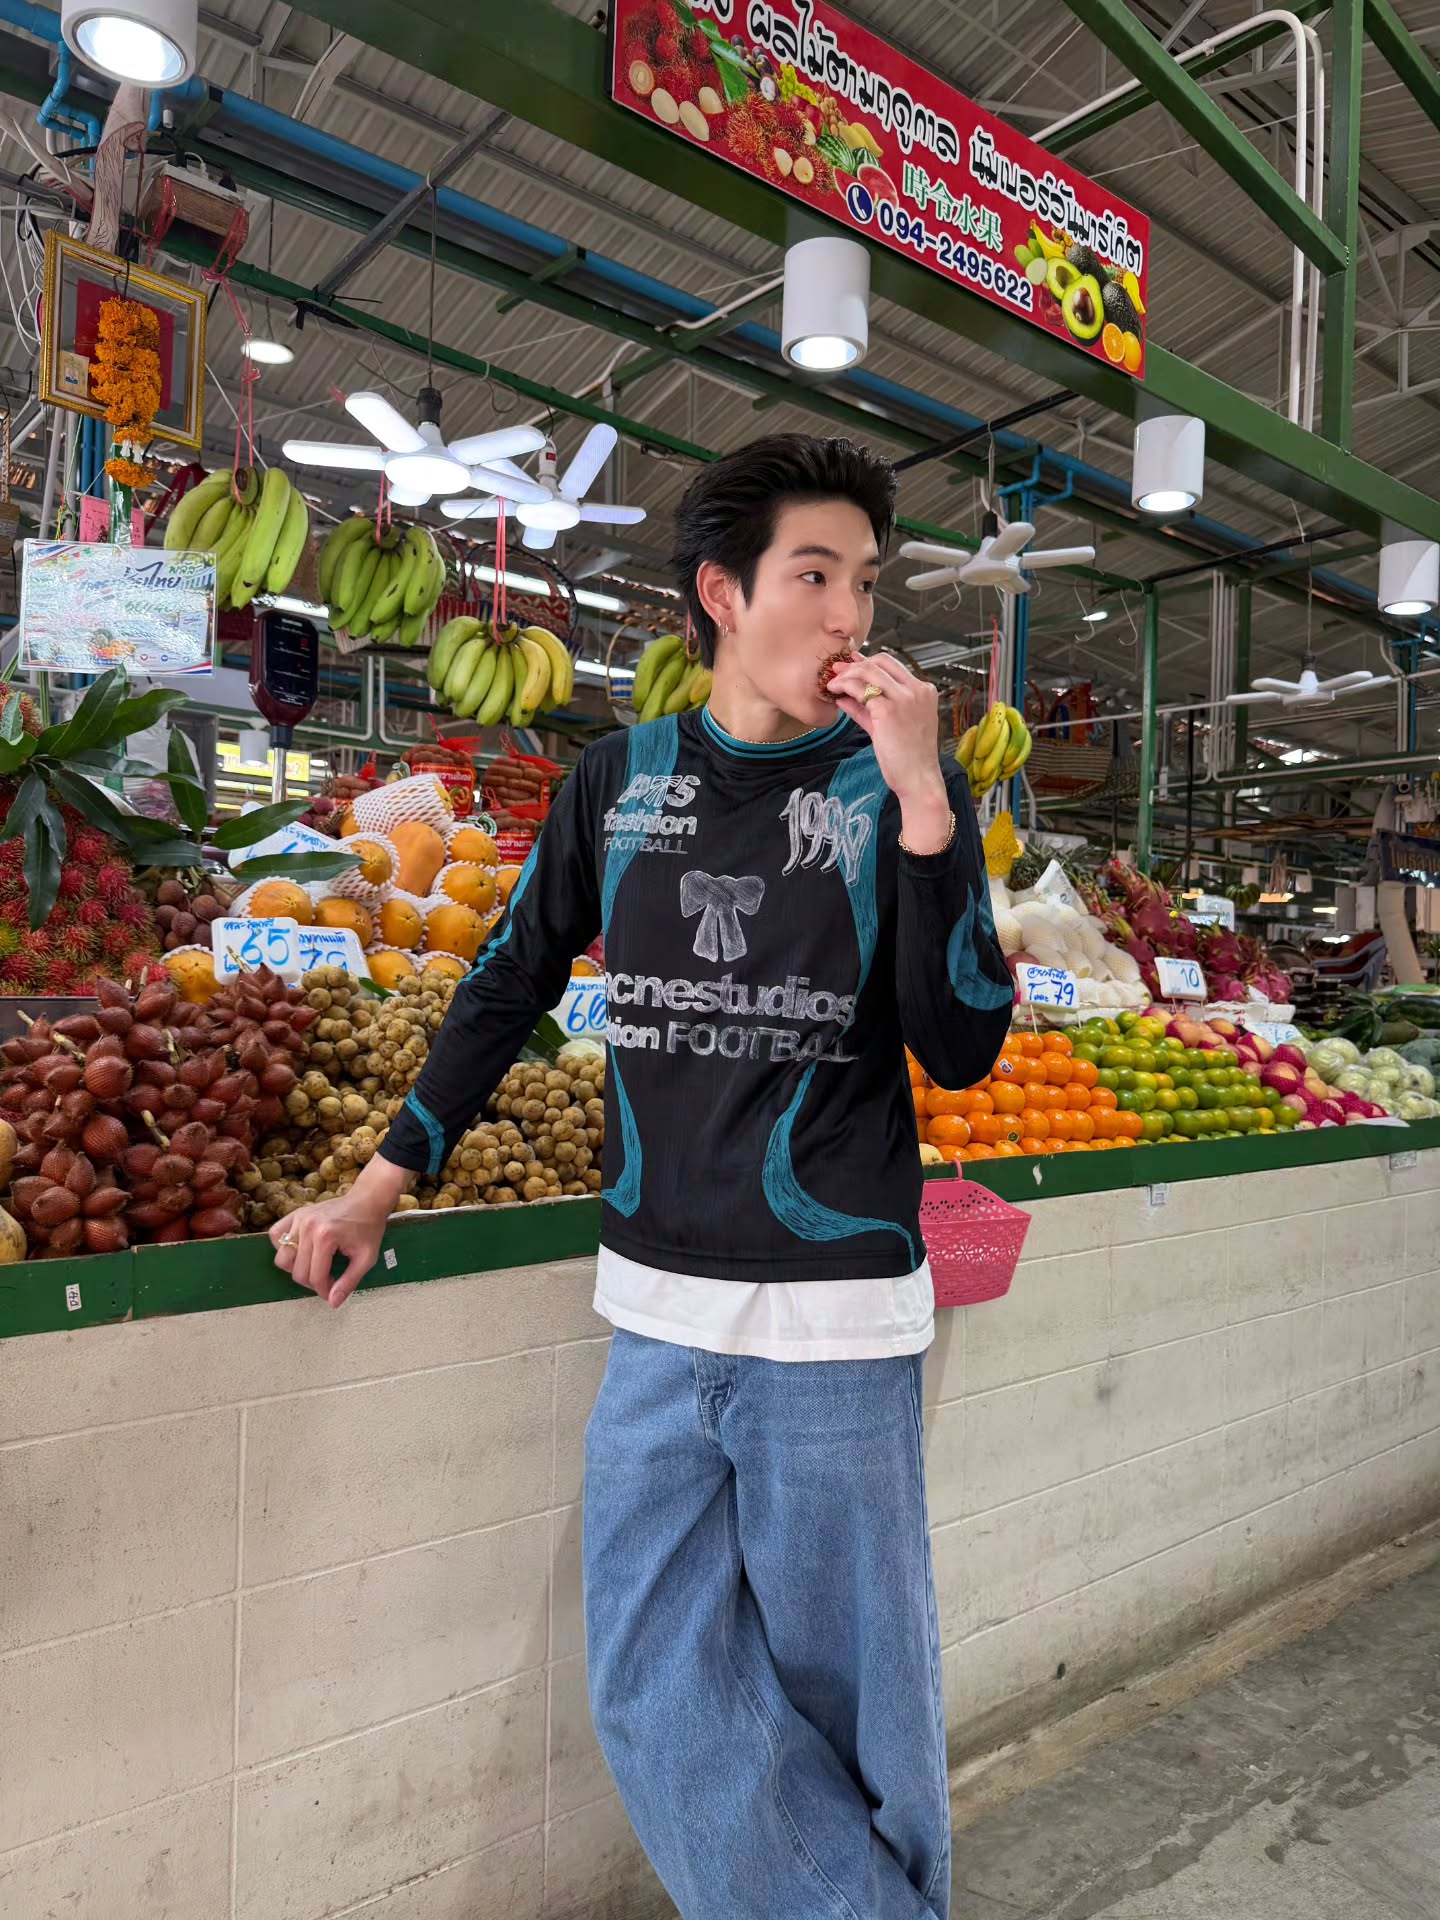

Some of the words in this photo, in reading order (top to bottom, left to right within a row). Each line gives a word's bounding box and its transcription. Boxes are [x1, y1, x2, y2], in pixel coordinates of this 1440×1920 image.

[903, 162, 1003, 251] 時令水果
[879, 203, 1031, 308] 094-2495622
[603, 807, 698, 836] fashion
[778, 787, 878, 888] 1996
[603, 836, 689, 855] FOOTBALL
[240, 928, 291, 966] 65
[1053, 979, 1074, 1006] 79
